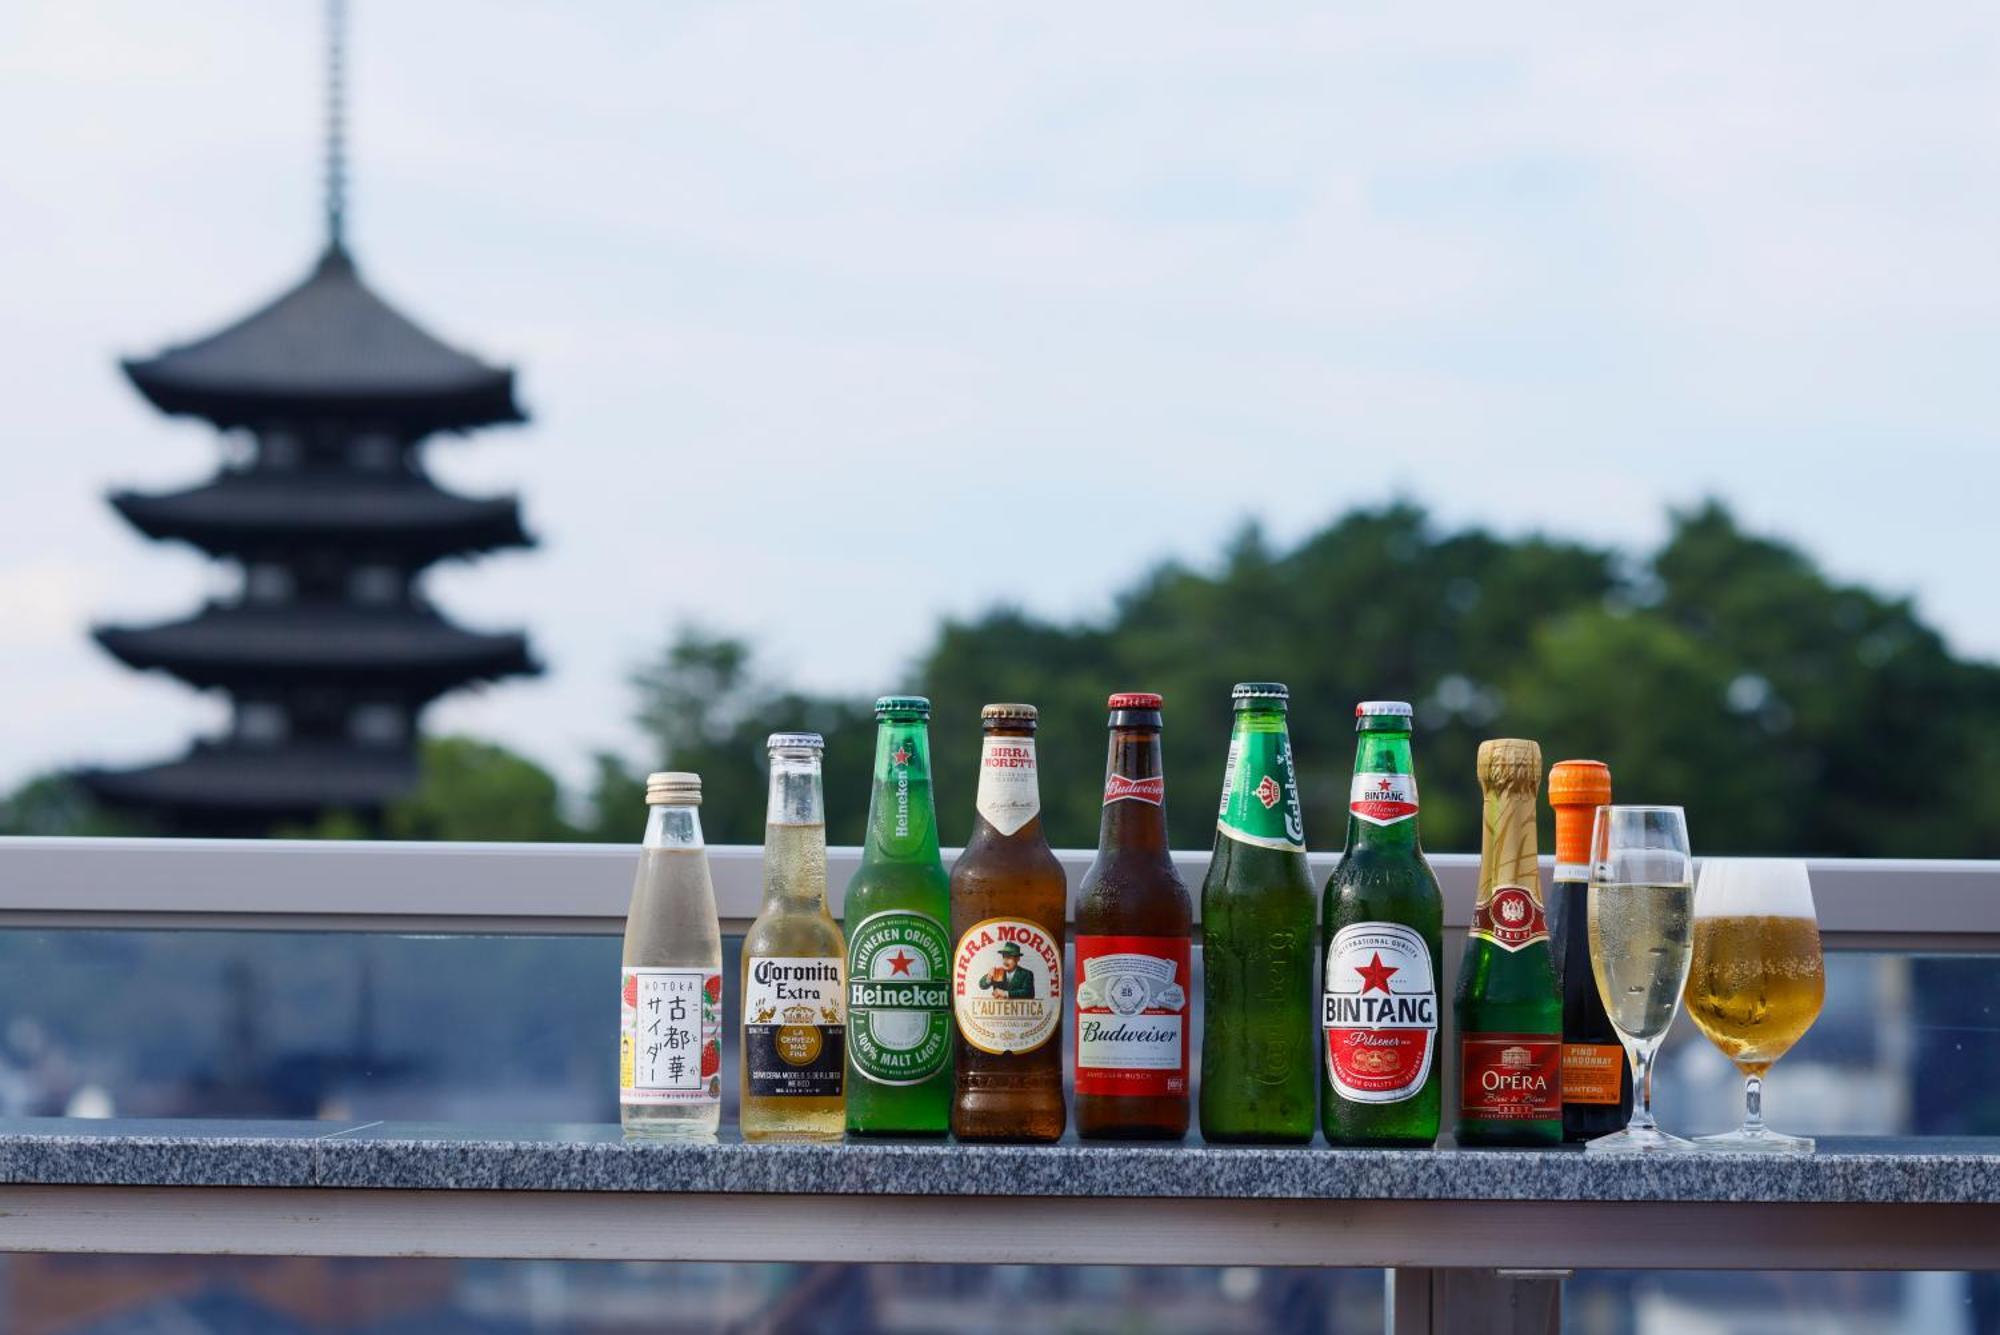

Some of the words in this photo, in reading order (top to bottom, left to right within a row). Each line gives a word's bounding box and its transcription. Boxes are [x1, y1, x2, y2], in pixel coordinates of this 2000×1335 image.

[992, 748, 1029, 757] BIRRA
[895, 770, 907, 837] Heineken
[1365, 791, 1404, 801] BINTANG
[857, 928, 900, 970] HEINEKEN
[904, 929, 944, 971] ORIGINAL
[957, 931, 994, 996] BIRRA
[997, 926, 1060, 997] MORETTI
[754, 961, 839, 986] Coronita
[776, 983, 820, 1000] Extra
[851, 984, 949, 1006] Heineken
[971, 1001, 1044, 1016] L'AUTENTICA
[1326, 998, 1433, 1023] BINTANG
[647, 997, 662, 1082] サイダー
[664, 996, 690, 1084] 古都華
[1081, 1021, 1177, 1043] Budweiser
[1349, 1031, 1398, 1046] Pilsener
[858, 1032, 878, 1060] 100%
[880, 1053, 911, 1067] MALT
[915, 1033, 943, 1063] LAGER
